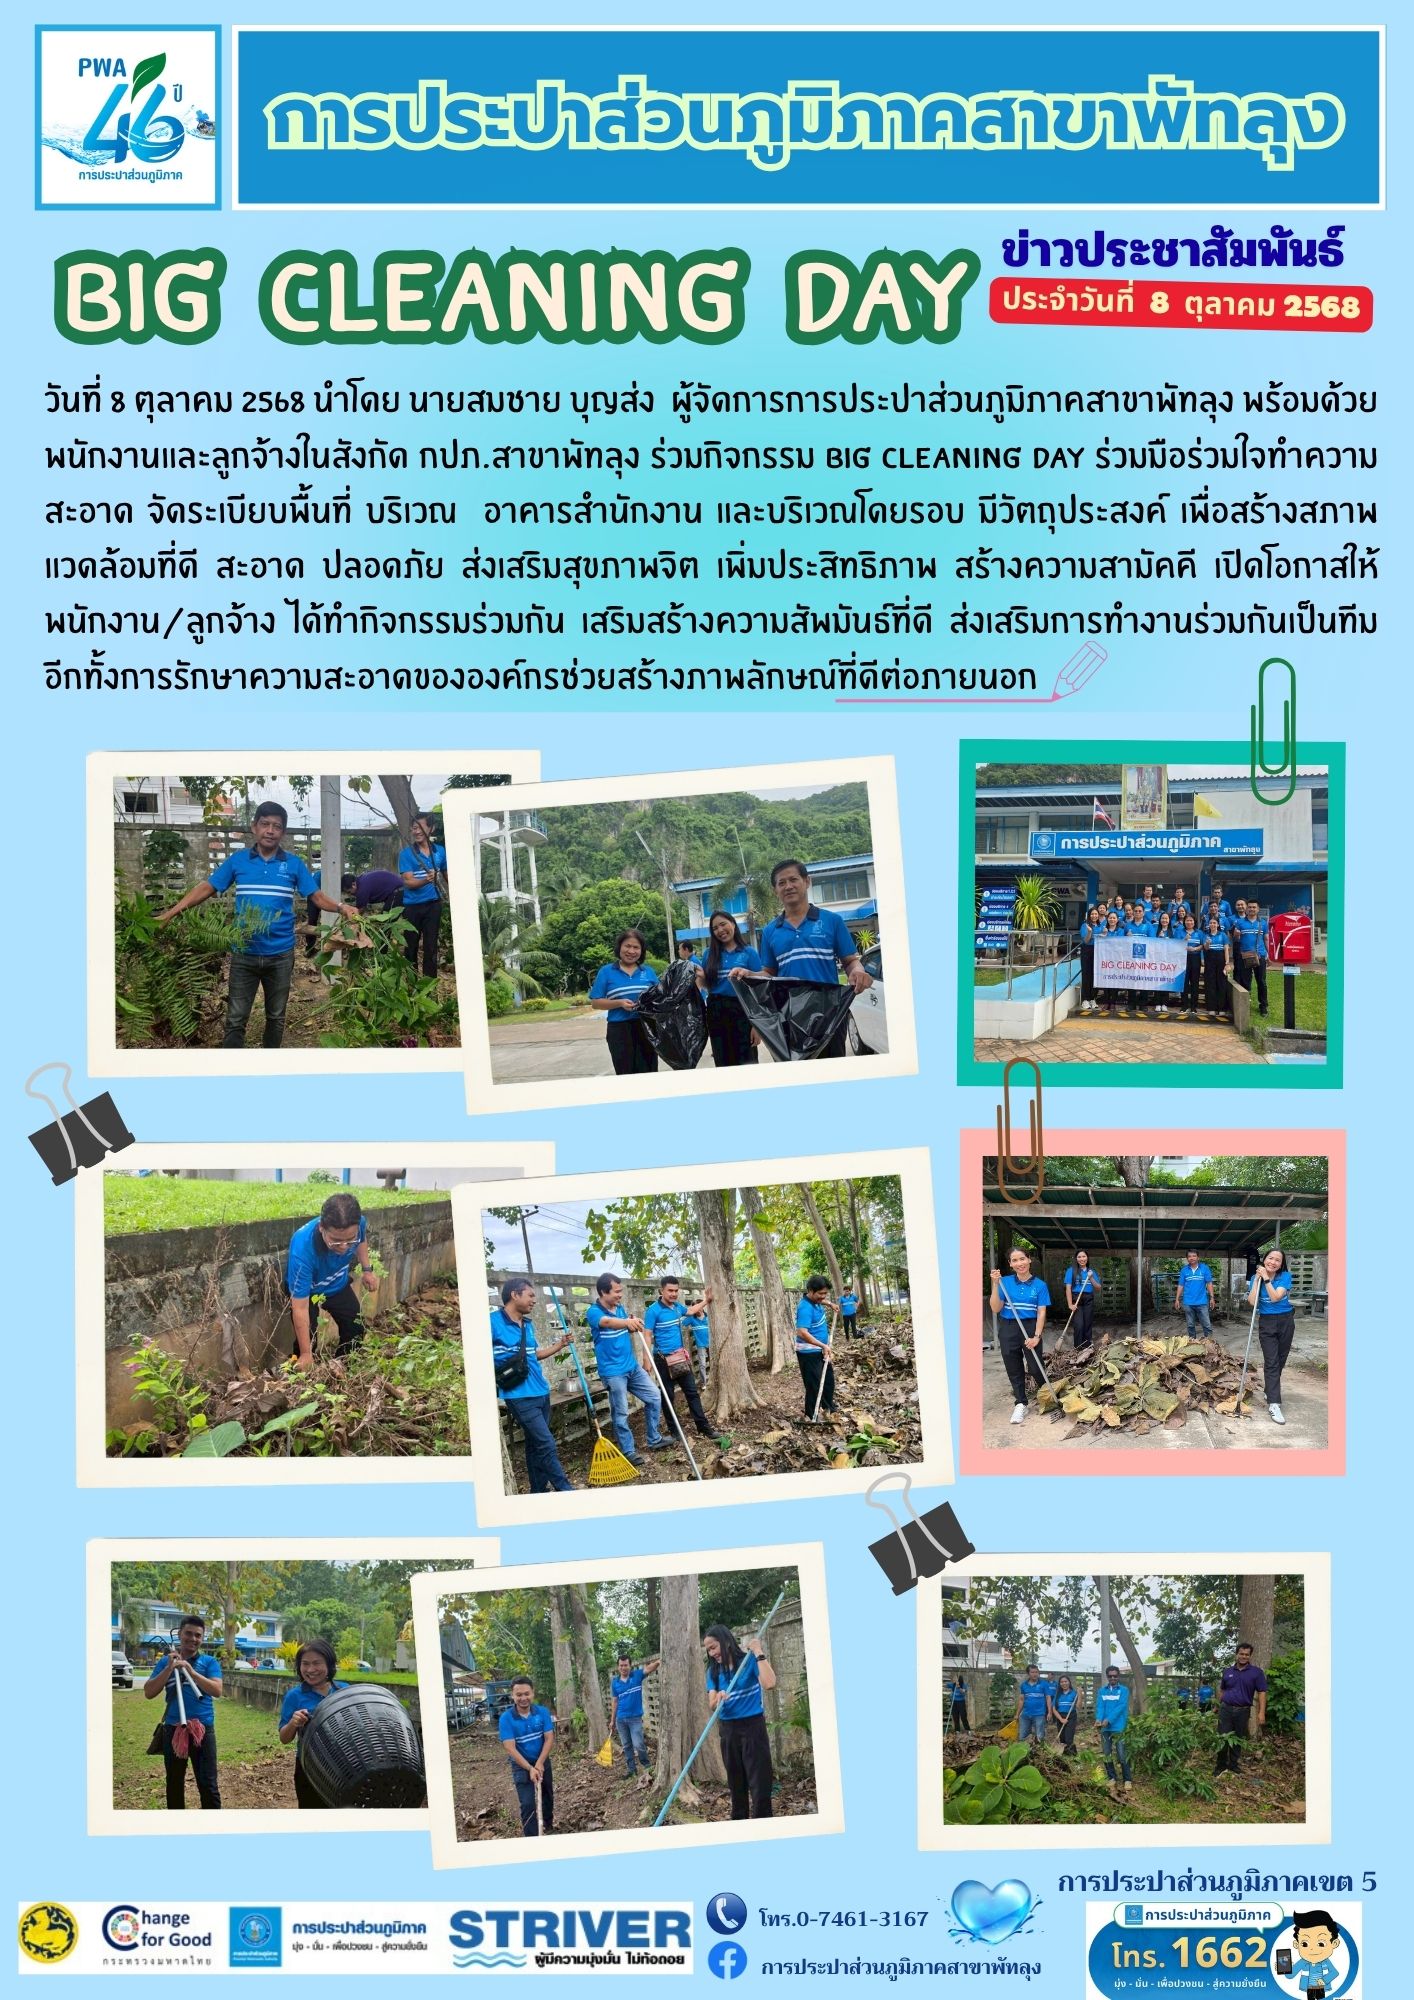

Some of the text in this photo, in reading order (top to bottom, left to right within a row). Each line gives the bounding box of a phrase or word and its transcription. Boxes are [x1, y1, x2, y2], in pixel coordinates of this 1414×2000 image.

[78, 57, 127, 77] PWA
[172, 84, 183, 103] ปี
[263, 75, 1346, 171] การประปาส่วนภูมิภาคสาขาพัทลุง
[78, 168, 183, 184] การประปาส่วนภูมิภาค
[1002, 224, 1346, 268] ข่าวประชาสัมพันธ์
[60, 254, 974, 338] BIG CLEANING DAY
[1003, 280, 1361, 322] ประจำวันที่ 8 ตุลาคม 2568
[45, 375, 1377, 424] วันที่ 8 ตุลาคม 2568 นำโดย นายสมชาย บุญส่ง ผู้จัดการการประปาส่วนภูมิภาคสาขาพัทลุง พร้อมด้วย
[45, 432, 1377, 480] พนักงานและลูกจ้างในสังกัด กปภ.สาขาพัทลุง ร่วมกิจกรรม BIG CLEANING DAY ร่วมมือร่วมใจทำความ
[45, 484, 1377, 535] สะอาด จัดระเบียบพื้นที่ บริเวณ อาคารสำนักงาน และบริเวณโดยรอบ มีวัตถุประสงค์ เพื่อสร้างสภาพ
[45, 540, 1381, 590] แวดล้อมที่ดี สะอาด ปลอดภัย ส่งเสริมสุขภาพจิต เพิ่มประสิทธิภาพ สร้างความสามัคคี เปิดโอกาสให้
[45, 601, 275, 645] พนักงาน/ลูกจ้าง
[283, 597, 564, 634] ได้ทำกิจกรรมร่วมกัน
[950, 599, 1377, 634] ส่งเสริมการทำงานร่วมกันเป็นทีม
[1060, 833, 1222, 854] การประปาส่วนภูมิภาค
[1101, 960, 1178, 972] BIG CLEANING DAY
[1058, 1867, 1377, 1902] การประปาส่วนภูมิภาคเขต 5
[292, 1920, 427, 1938] การประปาส่วนภูมิภาค
[449, 1910, 692, 1949] STRIVER
[759, 1907, 929, 1927] โทร.0-7461-3167
[1145, 1906, 1271, 1924] การประปาส่วนภูมิภาค
[142, 1932, 212, 1947] for Good
[1111, 1936, 1268, 1969] โทร. 1662
[535, 1950, 685, 1968] ผู้มีความมุ่งมั่น ไม่ท้อถอย
[762, 1956, 1041, 1982] การประปาส่วนภูมิภาคสาขาพัทลุง
